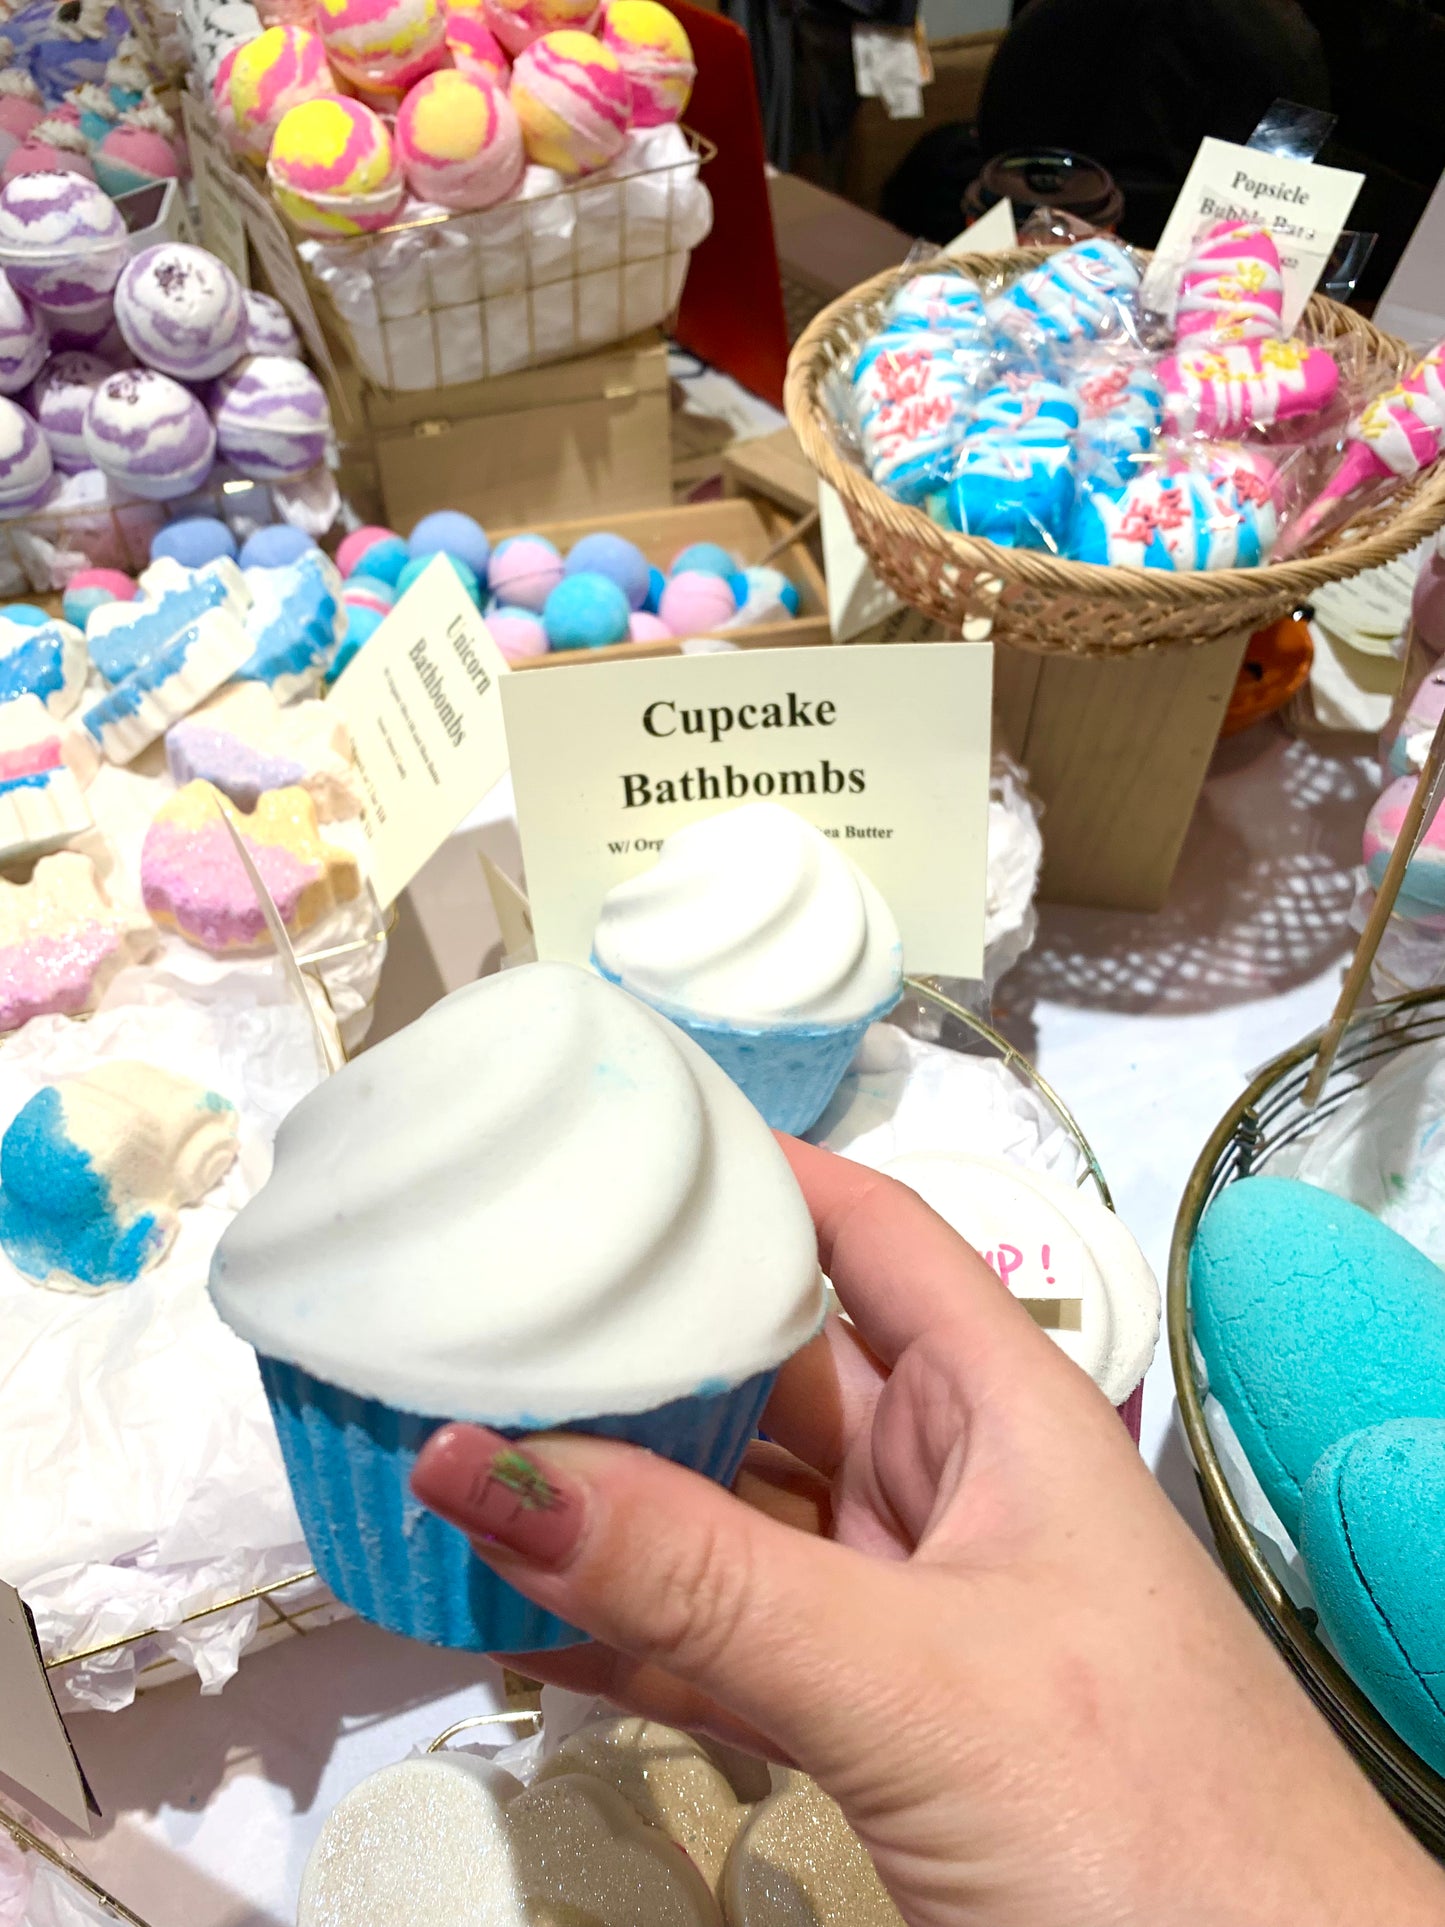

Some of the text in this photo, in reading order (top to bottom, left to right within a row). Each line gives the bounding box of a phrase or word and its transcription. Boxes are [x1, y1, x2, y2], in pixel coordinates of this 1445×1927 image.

[1231, 171, 1310, 204] Popsicle
[446, 612, 491, 696] Unicorn
[408, 635, 467, 749] Bathbombs
[643, 691, 836, 742] Cupcake
[620, 760, 866, 809] Bathbombs
[845, 825, 893, 839] Butter
